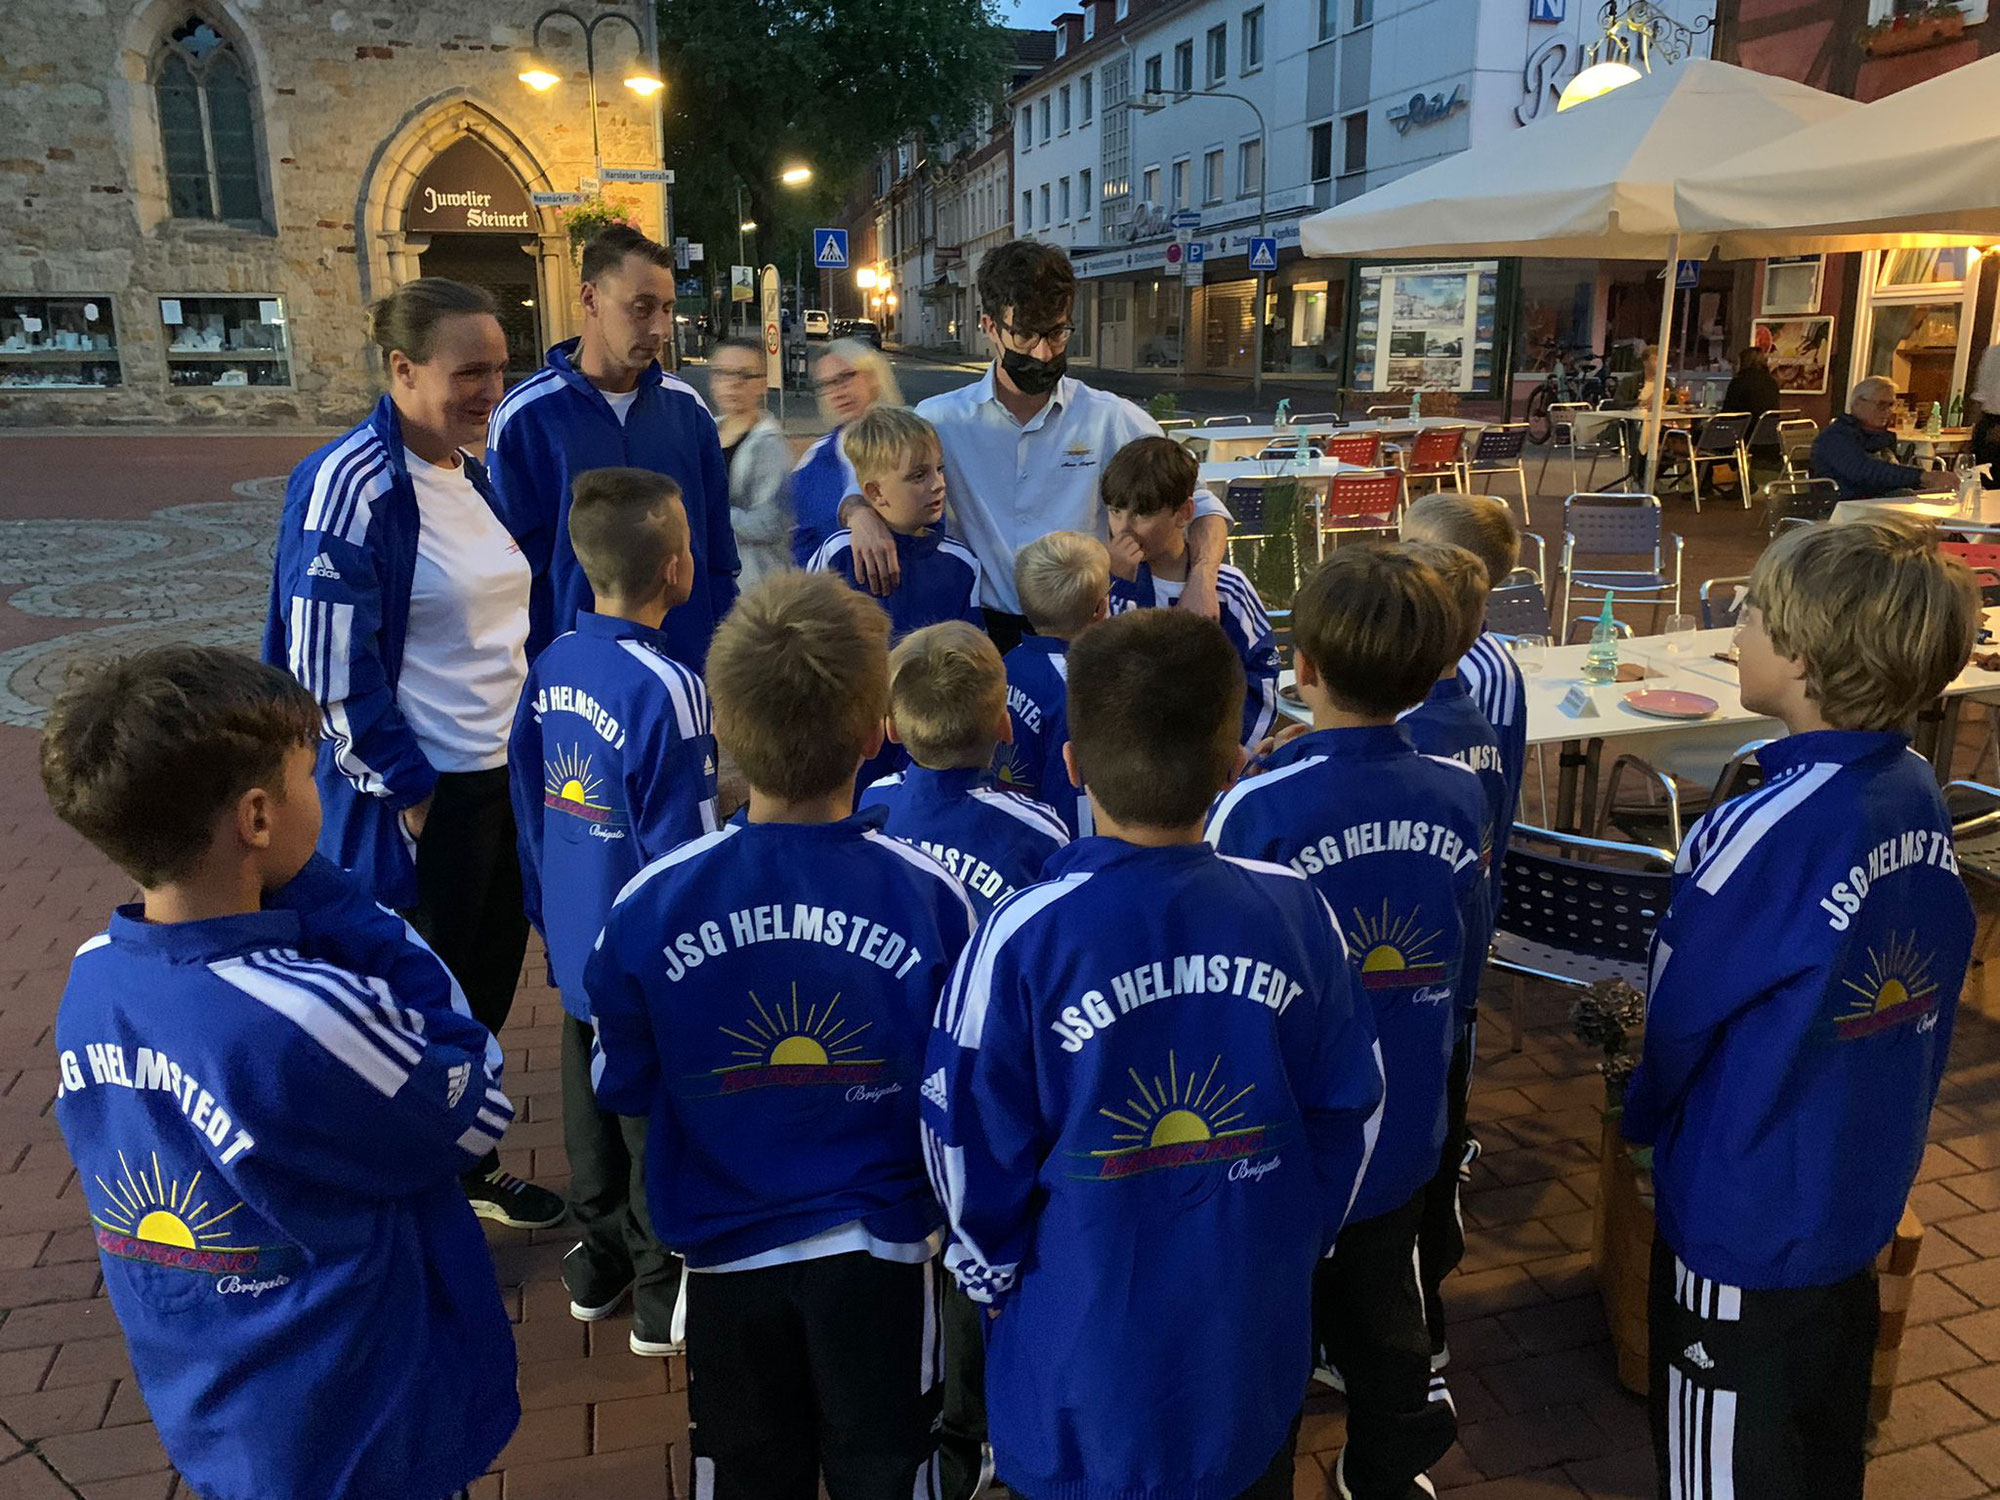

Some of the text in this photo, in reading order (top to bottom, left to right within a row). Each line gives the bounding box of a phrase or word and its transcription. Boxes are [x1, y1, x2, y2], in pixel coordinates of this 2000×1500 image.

[423, 187, 491, 213] Juwelier
[467, 208, 529, 227] Steinert
[1191, 244, 1201, 260] P
[306, 563, 341, 580] adidas
[549, 686, 626, 750] HELMSTEDT
[1343, 820, 1479, 874] HELMSTEDT
[1820, 866, 1869, 931] JSG
[662, 903, 922, 982] JSG HELMSTEDT
[1050, 954, 1304, 1053] JSG HELMSTEDT
[85, 1042, 255, 1165] HELMSTEDT
